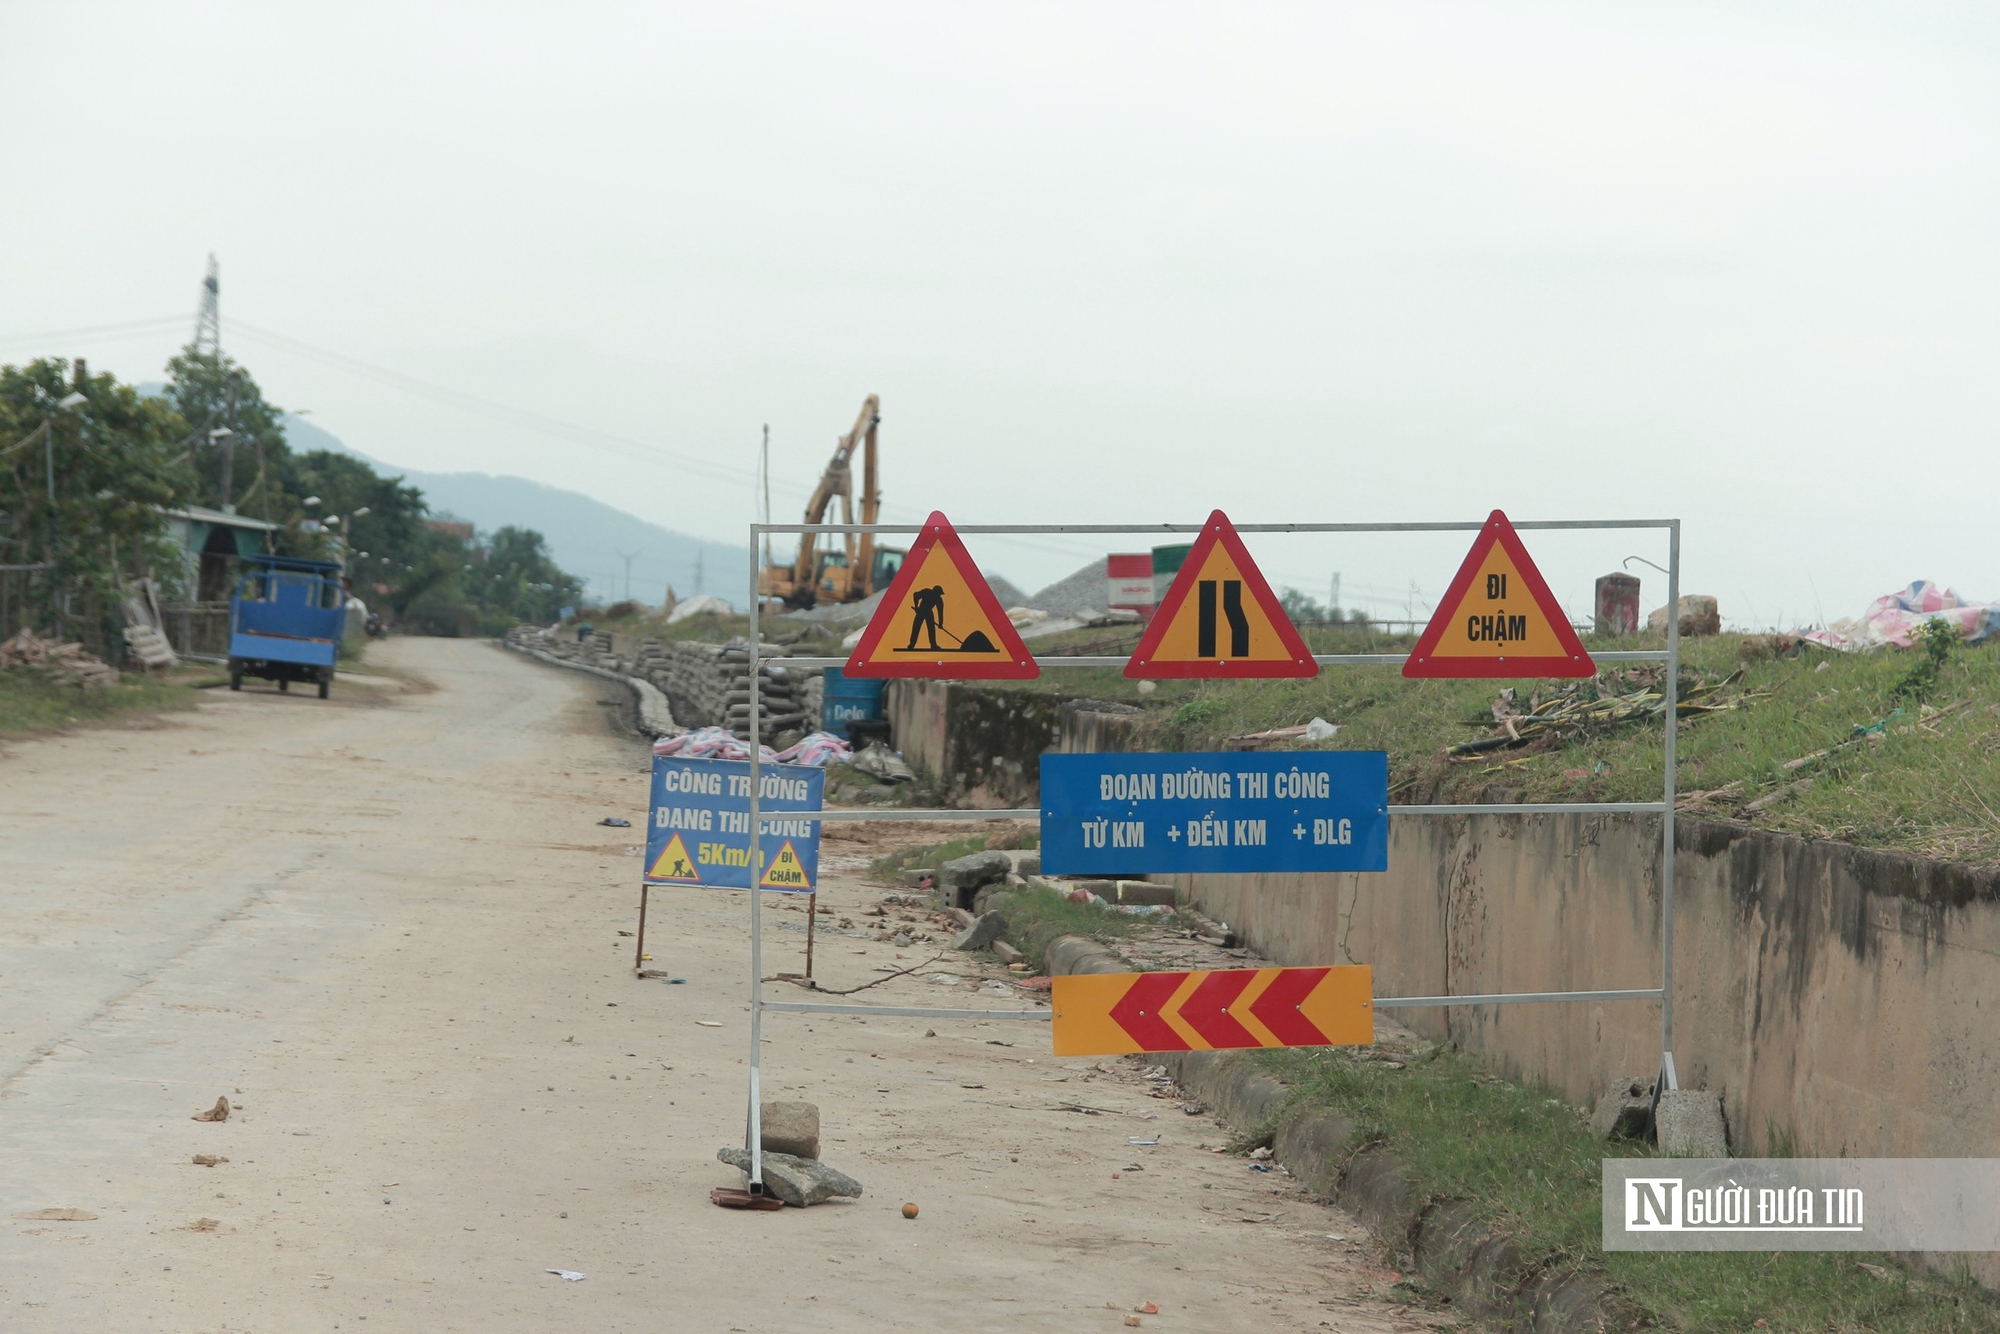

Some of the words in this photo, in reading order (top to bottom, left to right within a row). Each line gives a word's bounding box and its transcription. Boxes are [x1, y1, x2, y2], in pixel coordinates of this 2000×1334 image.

[1486, 573, 1507, 600] ĐI
[1467, 609, 1526, 647] CHẬM
[665, 767, 722, 795] CÔNG
[1100, 773, 1156, 806] ĐOẠN
[1161, 766, 1231, 799] ĐƯỜNG
[1237, 772, 1268, 799] THI
[1274, 766, 1330, 799] CÔNG
[656, 806, 712, 831] ĐANG
[718, 811, 750, 834] THI
[1081, 816, 1109, 848] TỪ
[1112, 821, 1145, 848] KM
[1234, 819, 1267, 846] KM
[1313, 818, 1352, 845] ĐLG
[781, 851, 793, 863] ĐI
[769, 869, 802, 885] CHẬM
